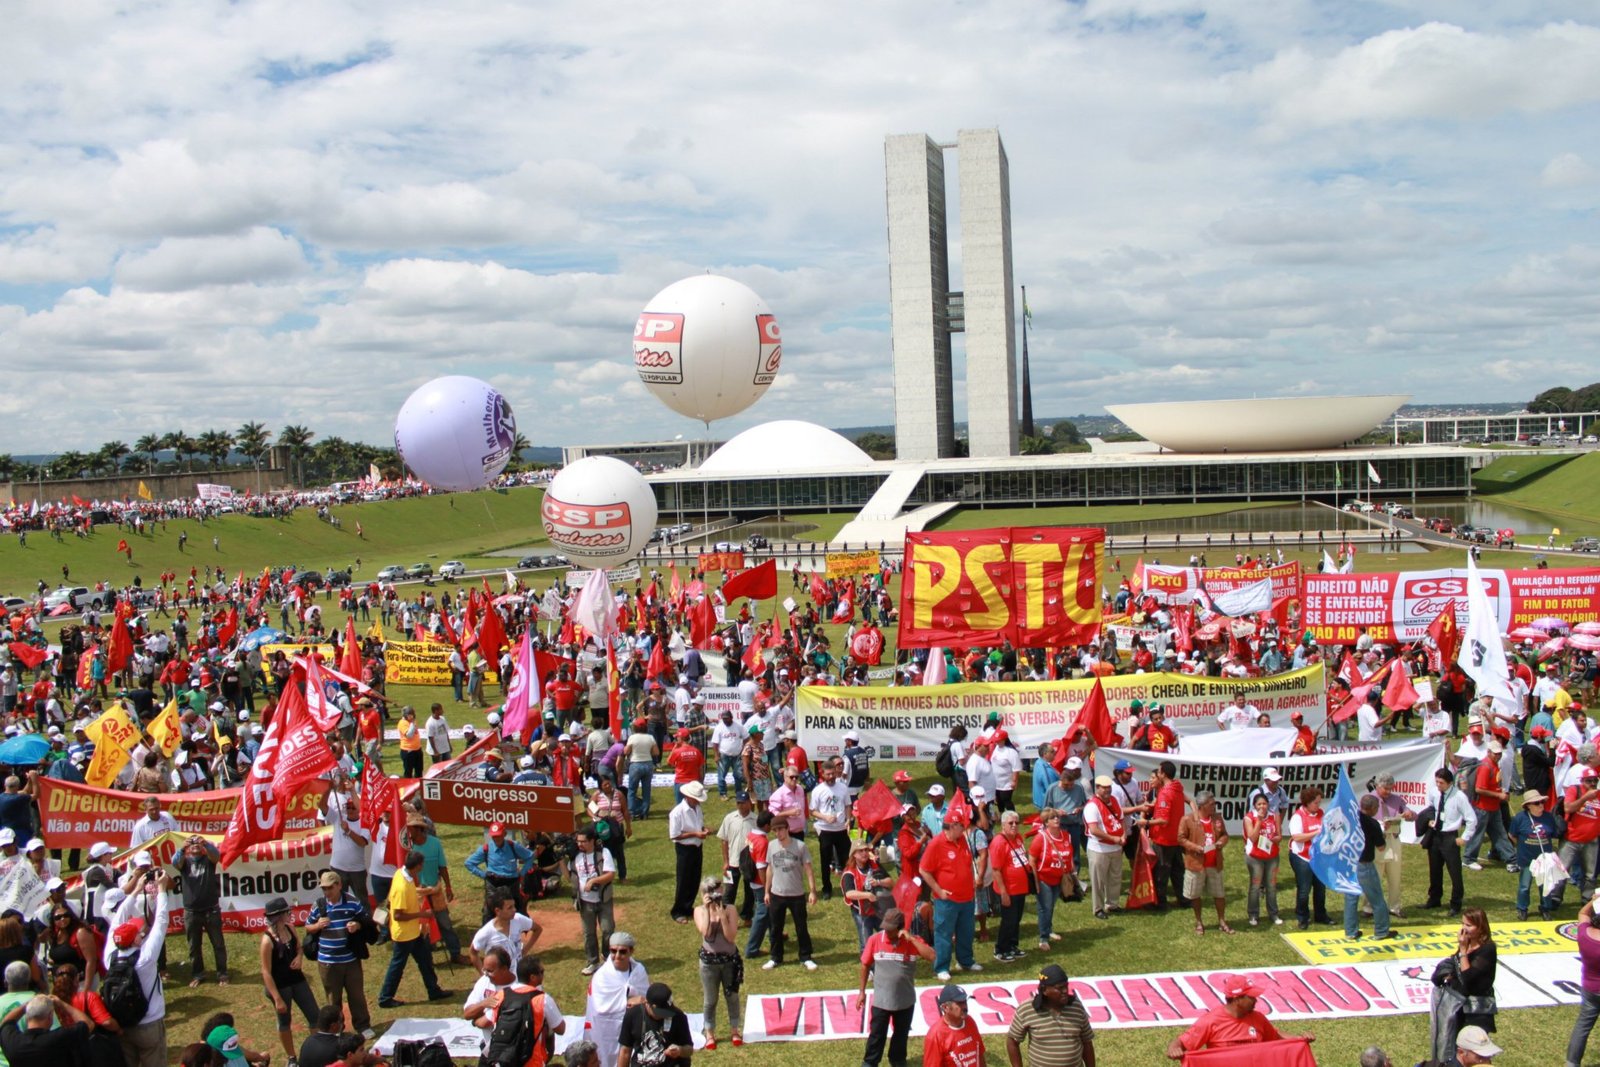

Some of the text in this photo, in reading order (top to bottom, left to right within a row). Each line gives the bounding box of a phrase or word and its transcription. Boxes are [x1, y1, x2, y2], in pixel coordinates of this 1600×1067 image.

[648, 374, 678, 382] POPULAR
[482, 391, 498, 450] Mulheres
[543, 501, 625, 526] CSP
[544, 521, 625, 547] Conlutas
[595, 547, 626, 556] POPULAR
[1205, 564, 1296, 580] #ForaFeliciano!
[913, 542, 1105, 630] PSTU
[1151, 574, 1182, 587] PSTU
[1205, 581, 1234, 591] CONTRA
[1287, 576, 1296, 586] DE
[1306, 576, 1389, 594] DIREITO NÃO
[1512, 574, 1600, 588] ANULAÇÃO DA REFORMA
[1519, 585, 1595, 597] DA PREVIDÊNCIA JÁ!
[1306, 596, 1388, 611] SE ENTREGA,
[1523, 598, 1591, 610] FIM DO FATOR
[1306, 610, 1386, 624] SE DEFENDE!
[1337, 626, 1356, 640] AO
[822, 675, 1307, 712] BASTA DE ATAQUES AOS DIREITOS DOS TRABALDORES! CHEGA DE ENTREGAR DINHEIRO
[718, 702, 740, 711] PRETO
[805, 715, 835, 730] PARA
[839, 715, 854, 730] AS
[857, 715, 912, 730] GRANDES
[915, 714, 982, 730] EMPRESAS!
[1019, 710, 1065, 725] VERBAS
[1164, 699, 1216, 721] DUCAÇÃO
[1179, 764, 1262, 782] DEFENDER
[1348, 762, 1357, 779] E
[452, 782, 538, 804] Congresso
[1194, 783, 1215, 798] NA
[1390, 781, 1427, 795] NIDADE
[48, 788, 132, 813] Direitos
[463, 805, 529, 825] Nacional
[47, 818, 71, 833] Não
[75, 821, 90, 833] ao
[93, 819, 135, 833] ACORD
[285, 817, 316, 830] ataca
[761, 992, 894, 1038] VIV
